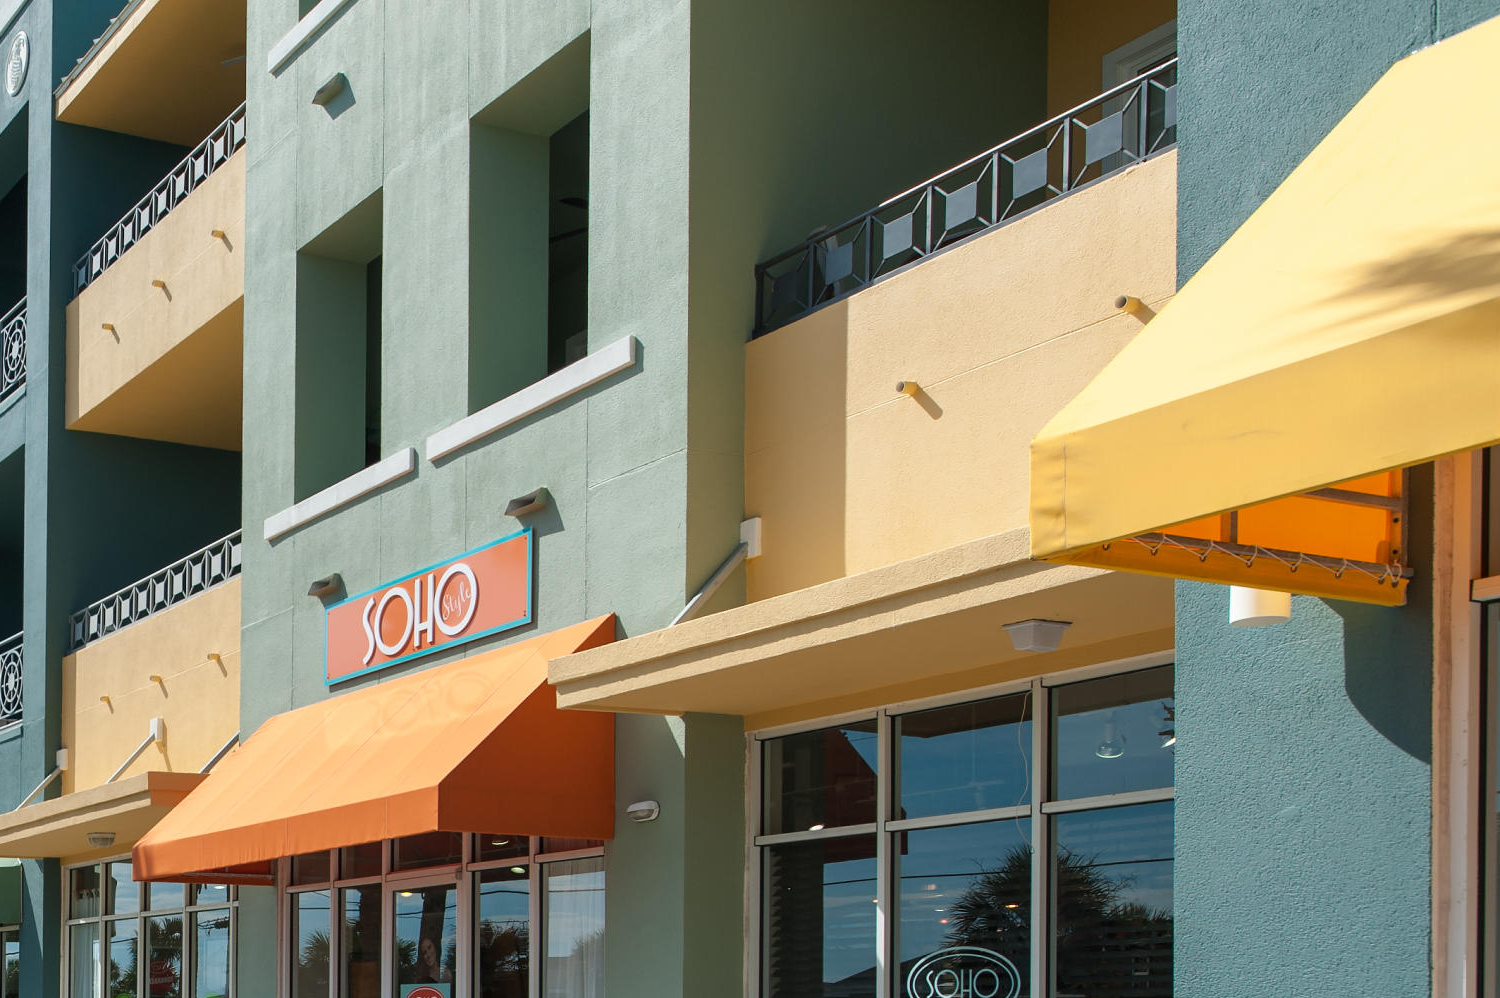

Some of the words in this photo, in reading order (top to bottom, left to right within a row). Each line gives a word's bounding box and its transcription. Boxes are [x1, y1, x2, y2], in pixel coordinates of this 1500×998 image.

[362, 563, 478, 665] SOHO
[442, 581, 471, 621] Style
[925, 968, 999, 998] SOHO
